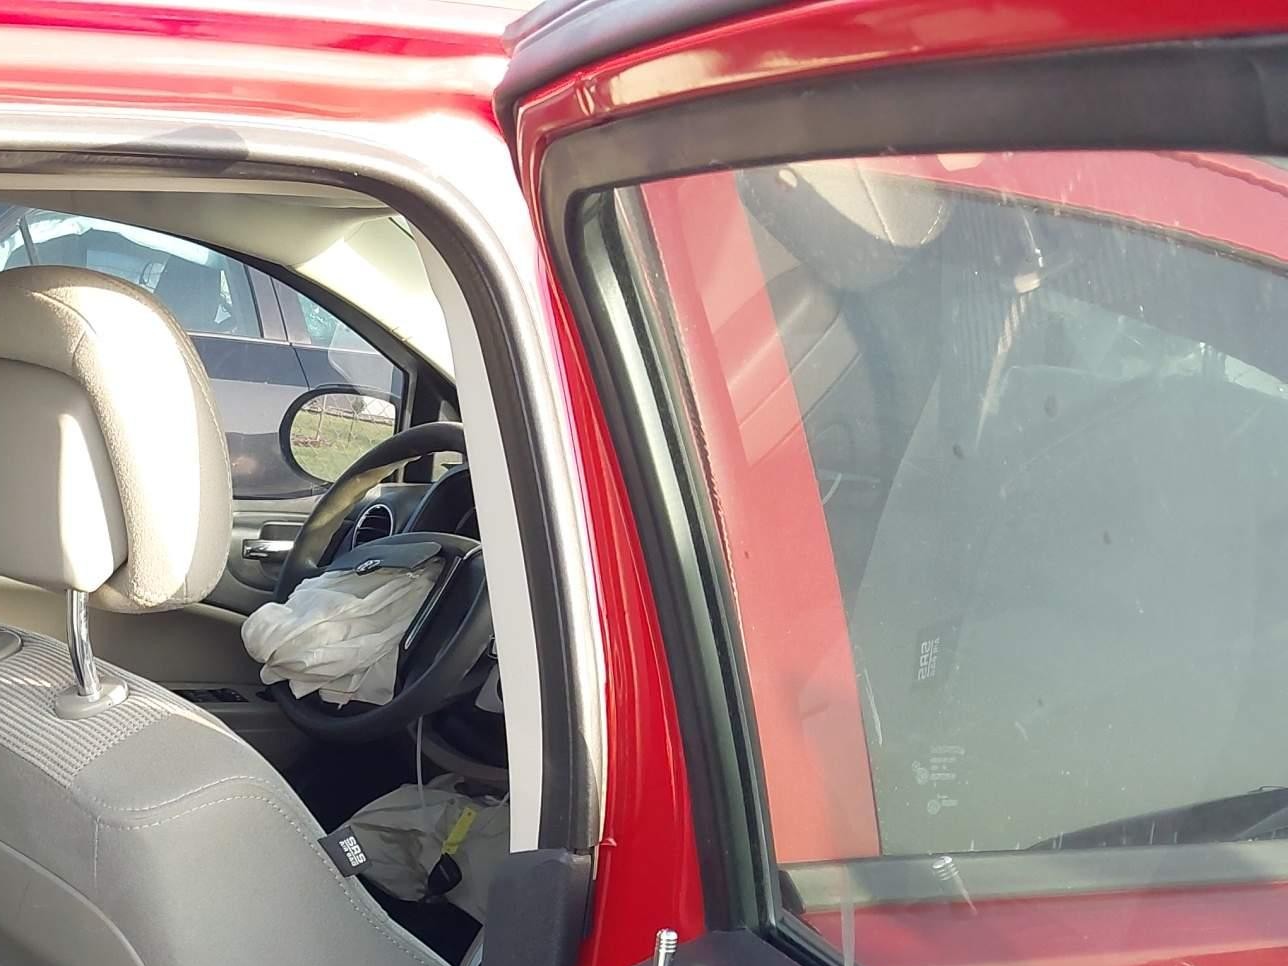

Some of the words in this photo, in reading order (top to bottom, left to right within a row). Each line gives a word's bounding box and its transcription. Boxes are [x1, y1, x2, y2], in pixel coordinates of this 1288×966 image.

[338, 840, 349, 852] AIR
[346, 852, 359, 867] BAG
[346, 836, 367, 863] SRS
